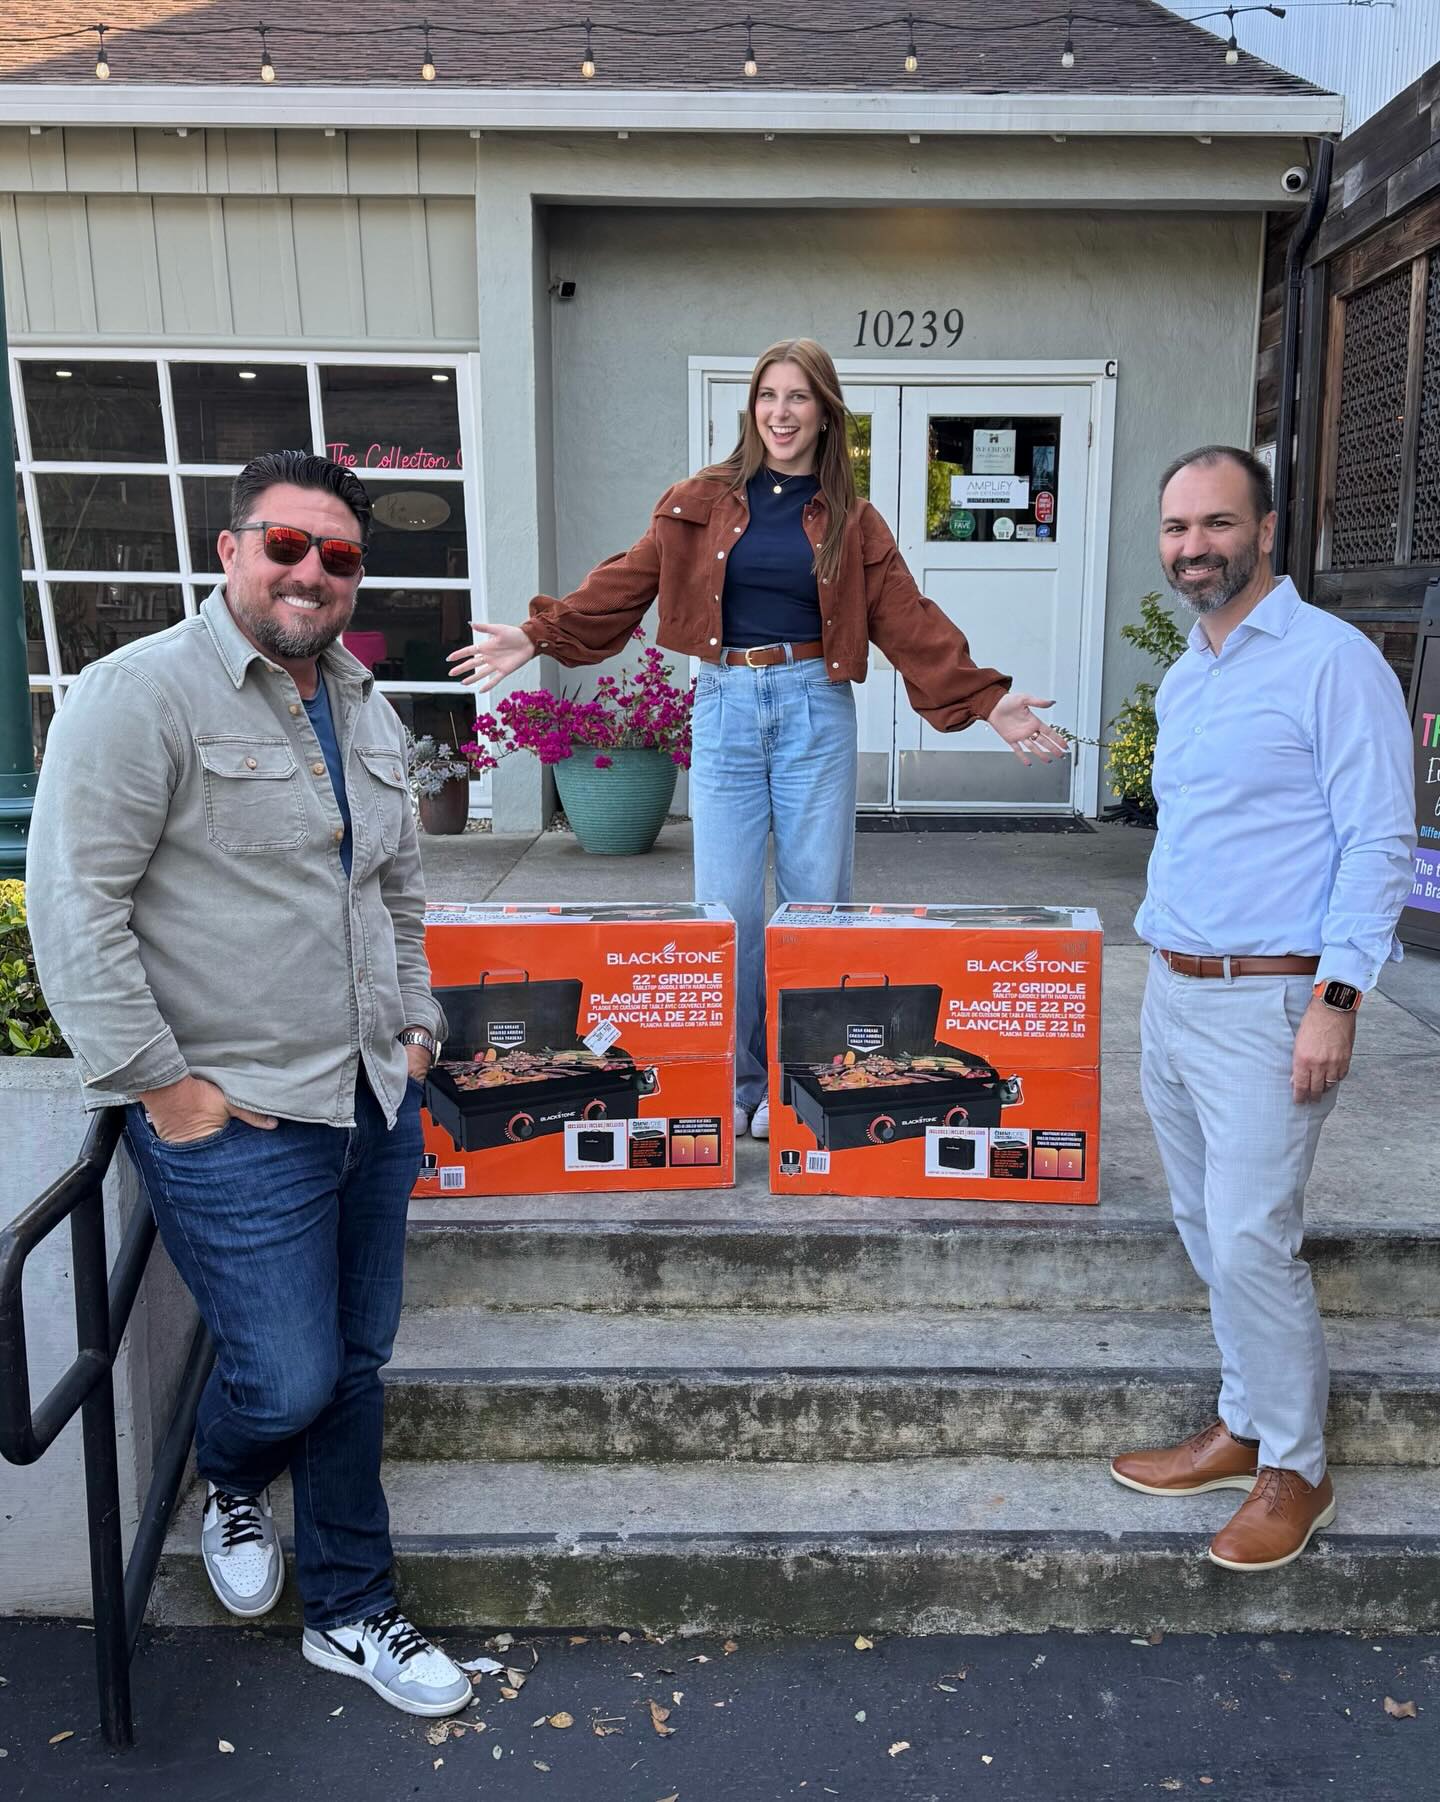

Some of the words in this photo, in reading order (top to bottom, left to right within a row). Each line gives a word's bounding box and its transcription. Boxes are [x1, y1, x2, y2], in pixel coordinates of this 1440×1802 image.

[853, 308, 964, 348] 10239
[1105, 360, 1116, 377] C
[326, 443, 358, 467] The
[365, 443, 450, 468] Collection
[967, 481, 1013, 491] AMPLIFY
[1415, 857, 1434, 876] The
[1412, 882, 1423, 895] in
[607, 950, 726, 966] BLACKSTONE
[966, 957, 1090, 973] BLACKSTONE
[632, 974, 656, 985] 22"
[658, 972, 723, 985] GRIDDLE
[992, 982, 1017, 993] 22"
[1019, 982, 1086, 994] GRIDDLE
[590, 993, 652, 1005] PLAQUE
[655, 992, 676, 1003] DE
[679, 991, 698, 1003] 22
[701, 991, 723, 1002] PO
[949, 1000, 1012, 1012] PLAQUE
[1016, 1001, 1036, 1012] DE
[1040, 1001, 1059, 1013] 22
[1063, 1002, 1086, 1013] PO
[587, 1011, 661, 1024] PLANCHA
[665, 1010, 685, 1022] DE
[688, 1010, 706, 1021] 22
[711, 1010, 723, 1021] in
[946, 1019, 1021, 1031] PLANCHA
[1025, 1020, 1046, 1031] DE
[1050, 1021, 1069, 1032] 22
[1073, 1020, 1086, 1032] in
[540, 1111, 576, 1121] BLACKSTONE
[901, 1116, 938, 1126] BLACKSTONE
